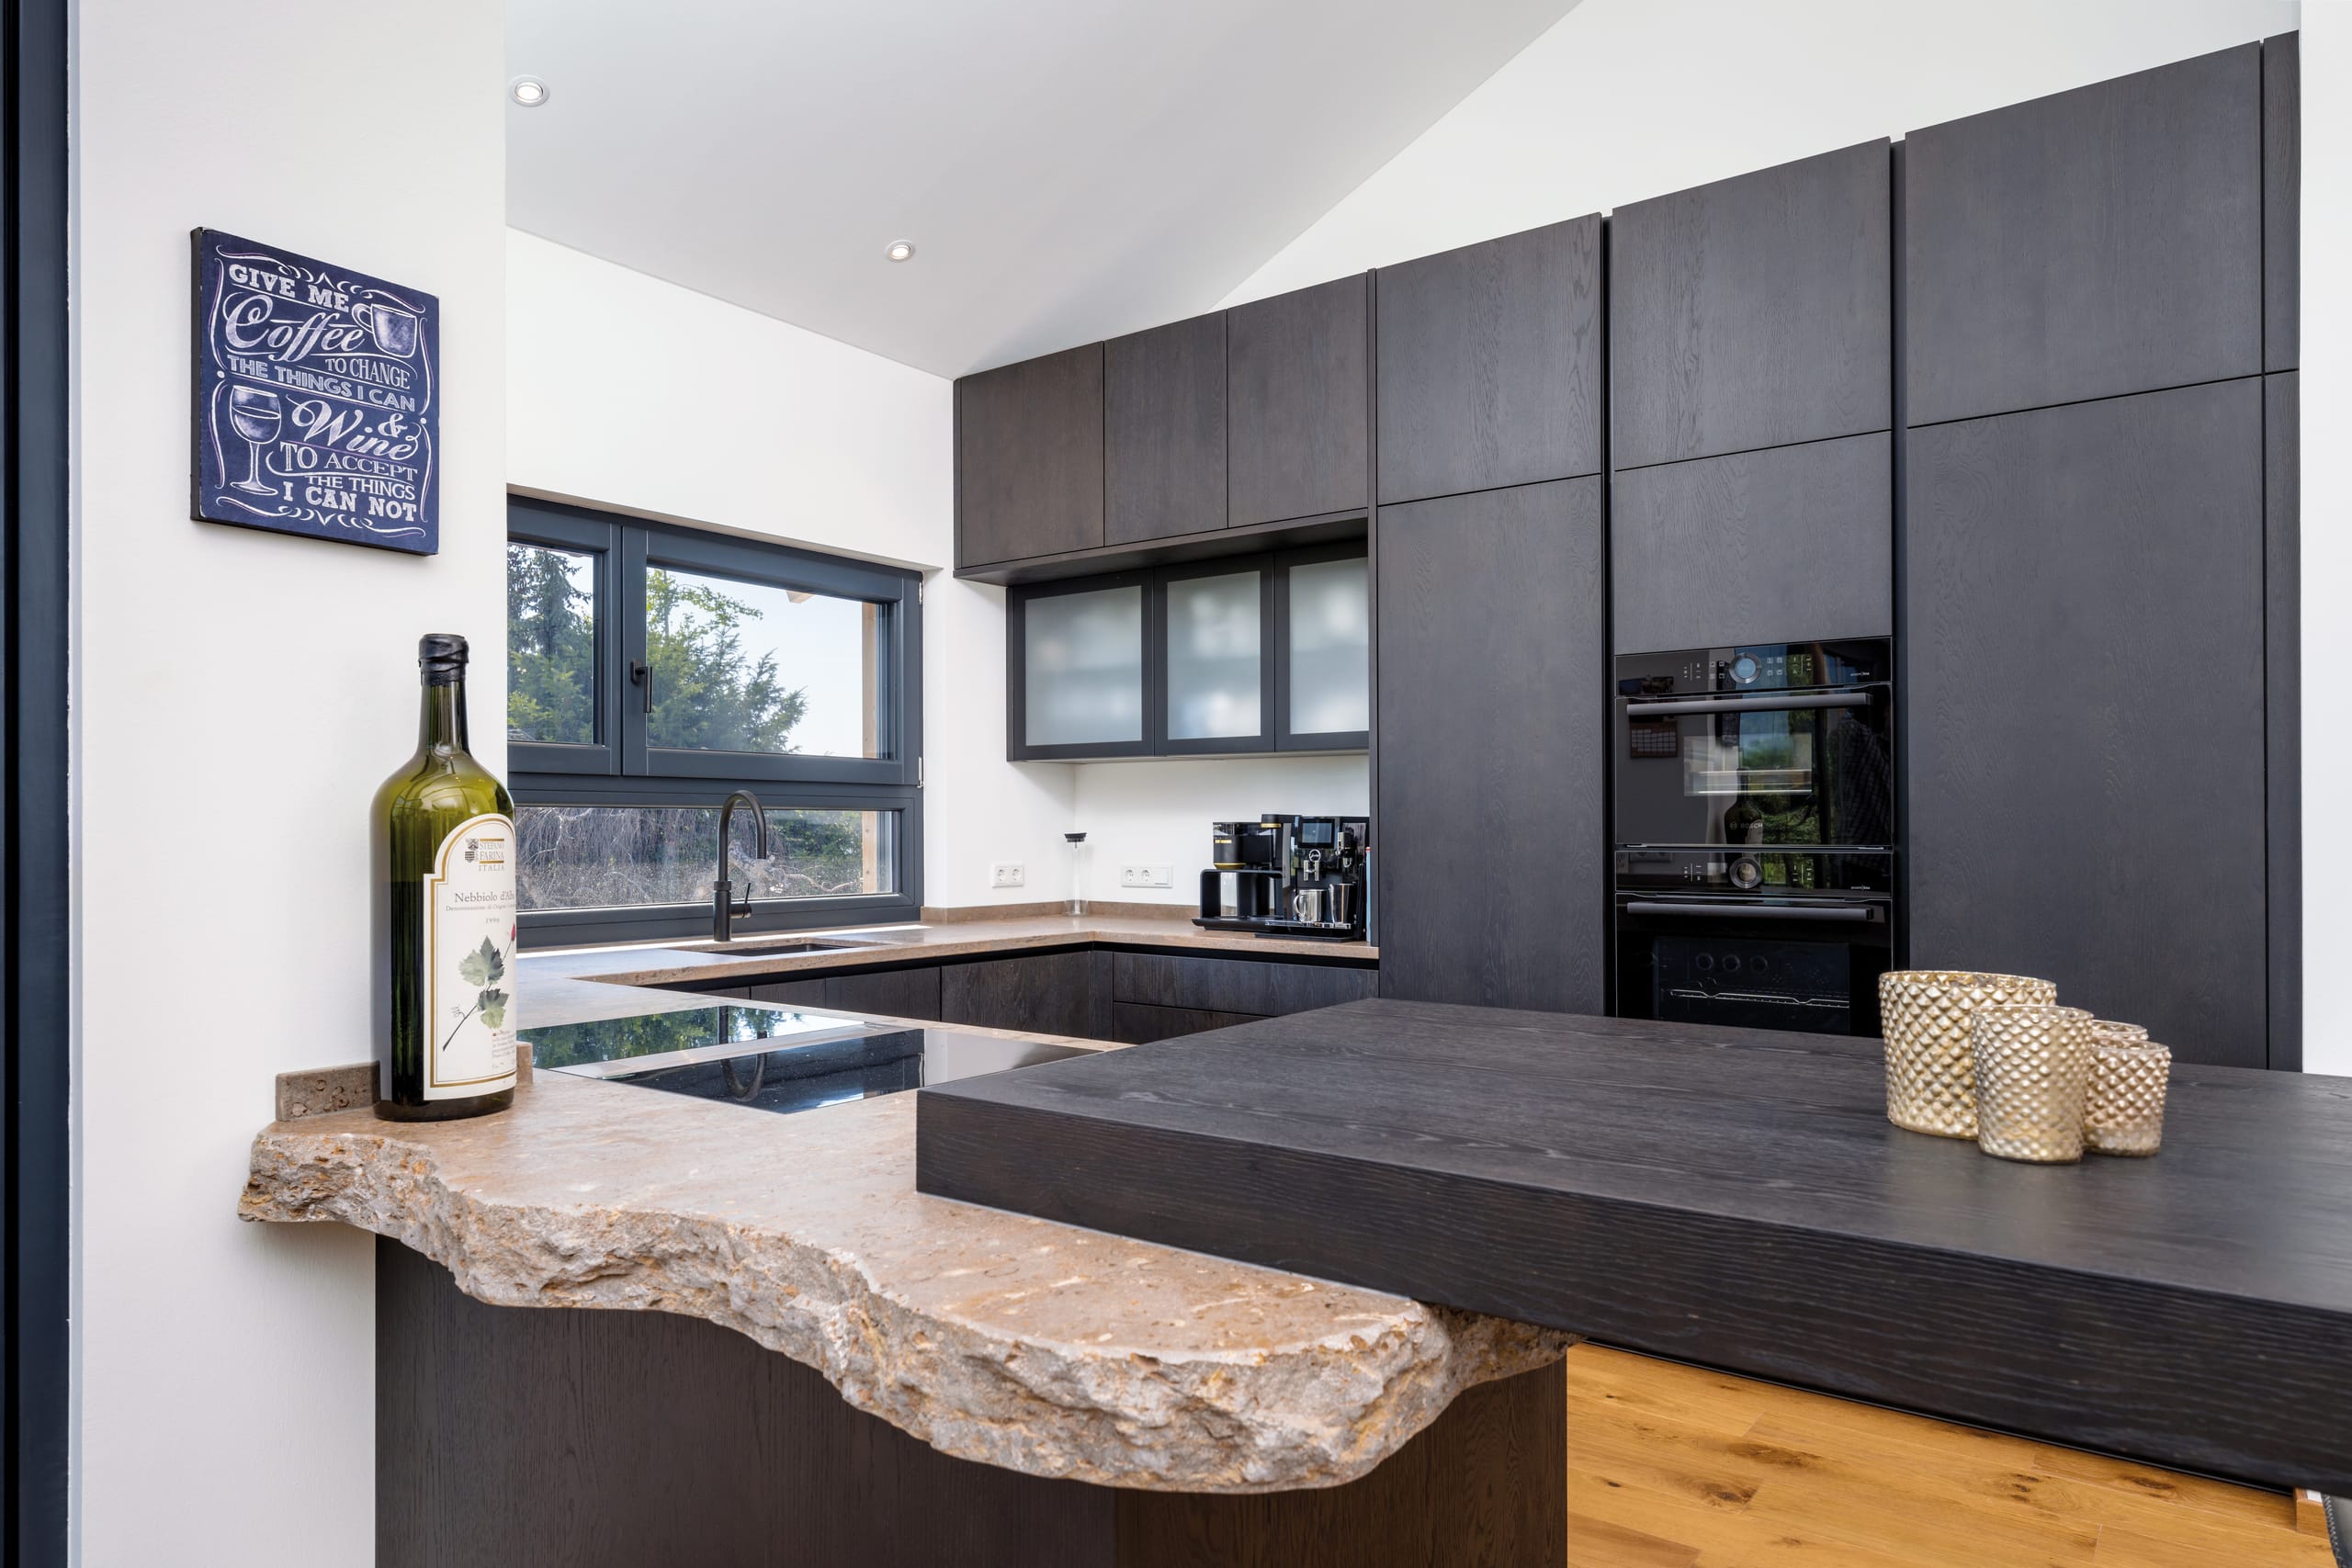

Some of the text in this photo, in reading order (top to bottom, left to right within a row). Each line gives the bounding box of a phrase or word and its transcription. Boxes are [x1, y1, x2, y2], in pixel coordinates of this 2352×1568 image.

[229, 263, 349, 313] GIVE ME
[222, 292, 366, 363] Coffee
[227, 355, 415, 412] THE THINGS I CAN
[325, 357, 411, 389] TO CHANGE
[286, 394, 422, 460] Wine
[378, 413, 408, 437] &
[279, 440, 418, 481] TO ACCEPT
[283, 480, 417, 523] I CAN NOT
[304, 474, 415, 501] THE THINGS
[480, 851, 504, 861] FARINA
[455, 891, 498, 903] Nebbiolo
